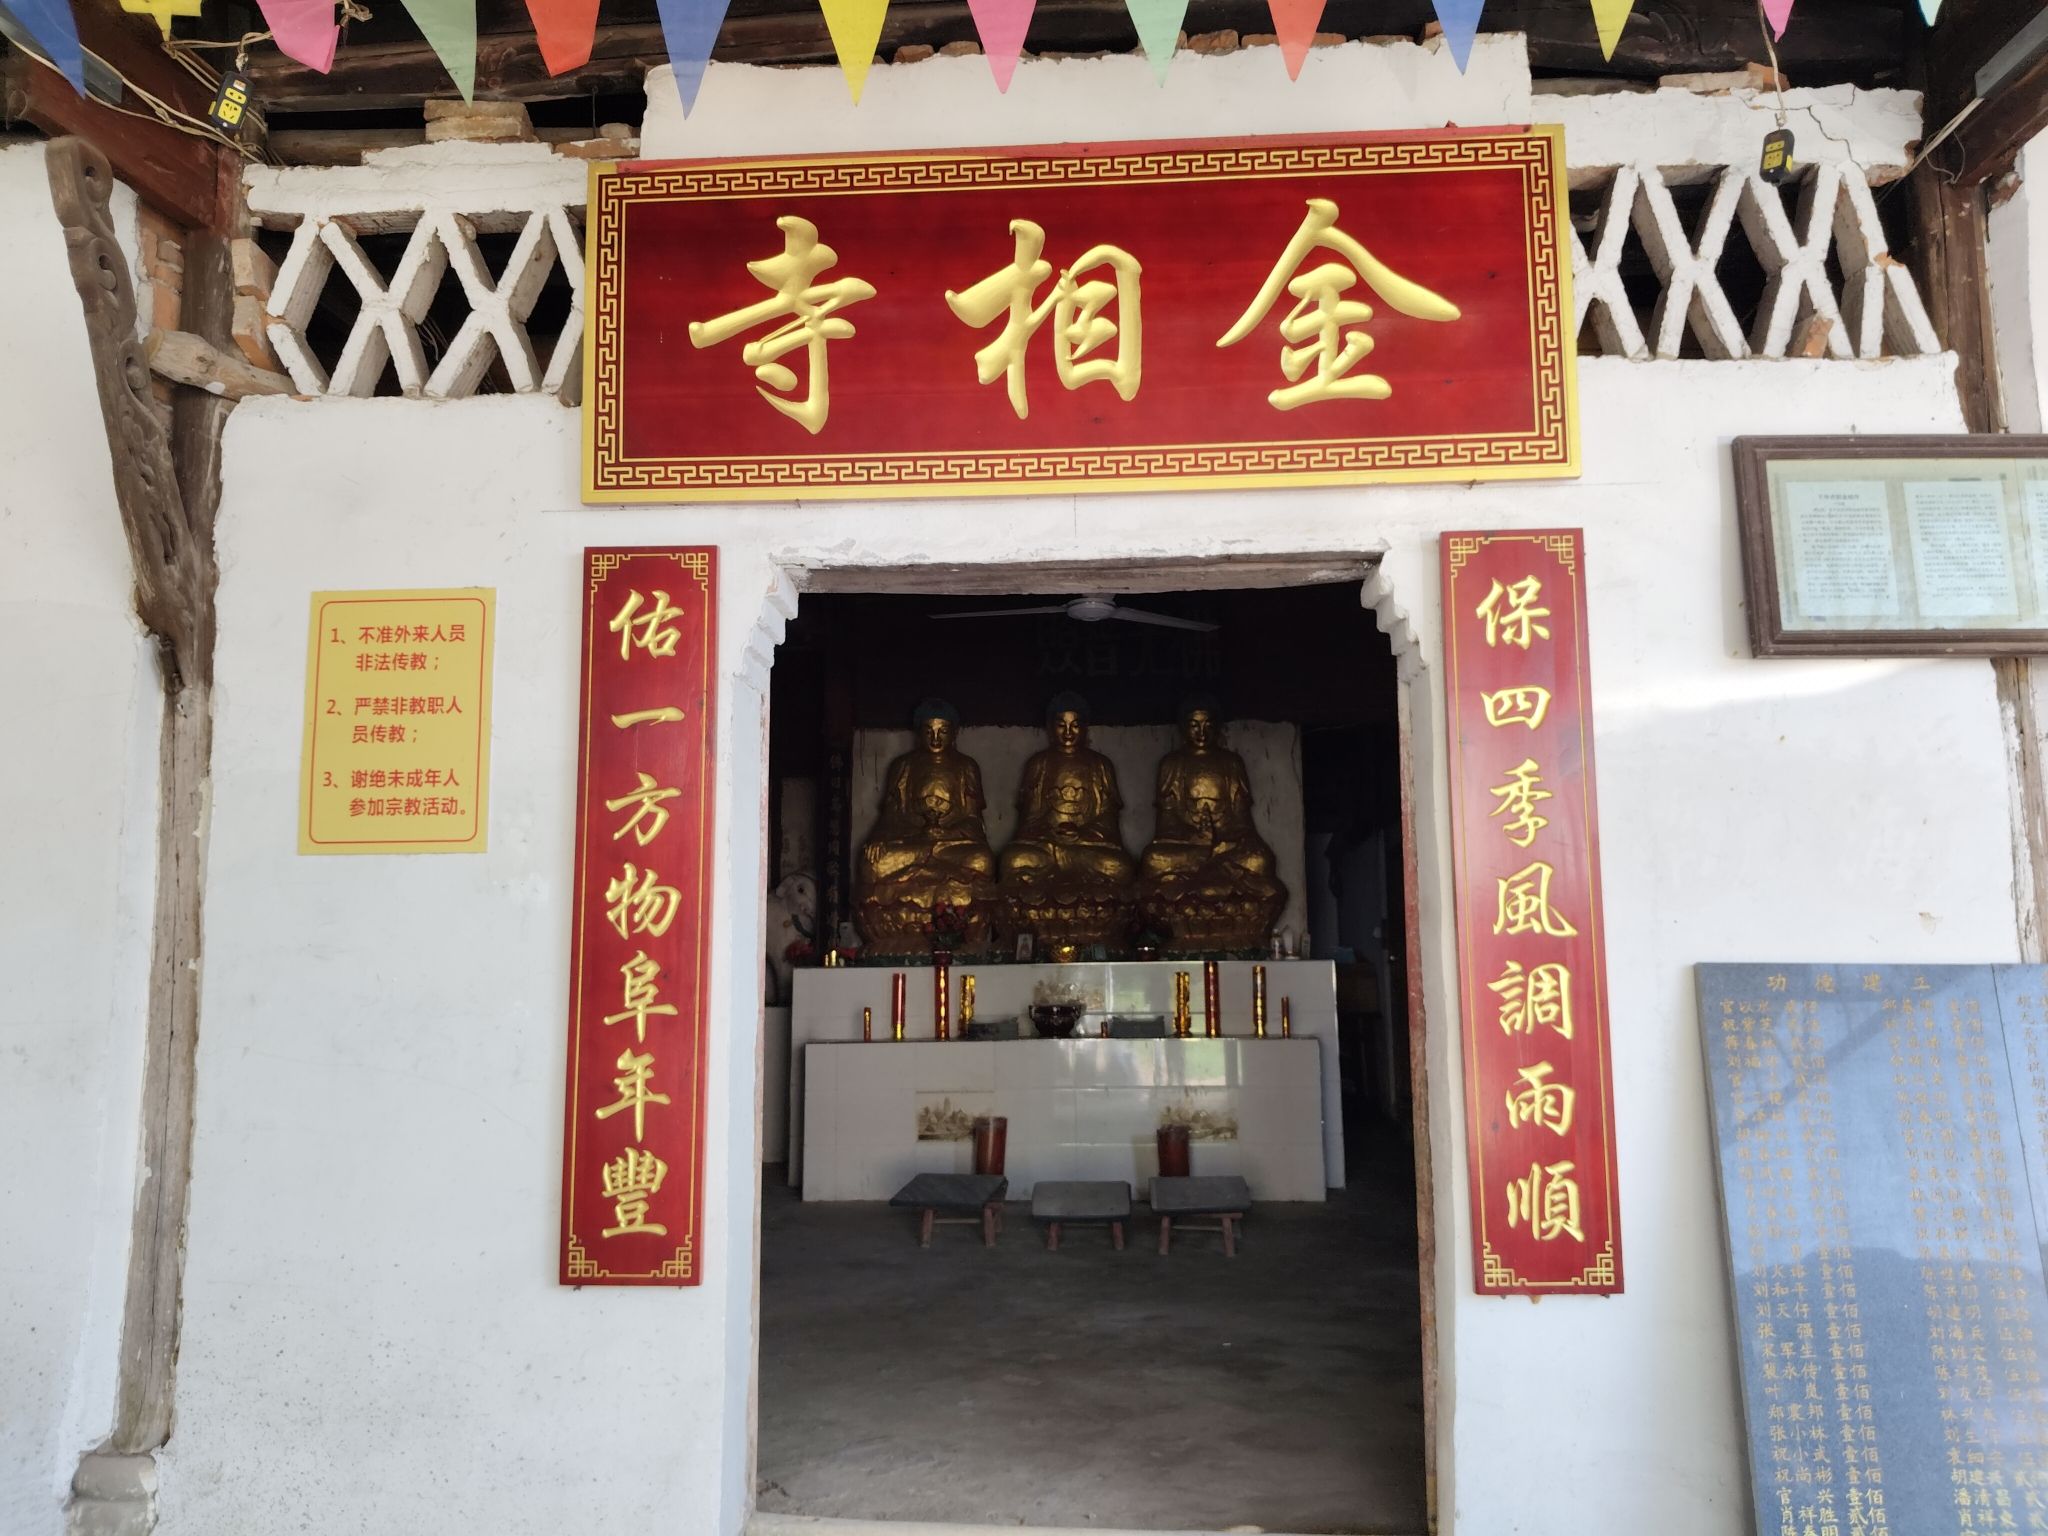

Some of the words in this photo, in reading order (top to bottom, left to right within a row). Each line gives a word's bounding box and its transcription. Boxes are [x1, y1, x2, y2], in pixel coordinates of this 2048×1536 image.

[331, 625, 466, 644] 1、不准外来人员
[355, 653, 440, 672] 非法传教；
[326, 696, 463, 716] 2、严禁非教职人
[352, 725, 418, 744] 员传教；
[323, 769, 460, 788] 3、谢绝未成年人
[349, 797, 466, 817] 参加宗教活动。
[1476, 575, 1586, 1243] 保四季風調雨順
